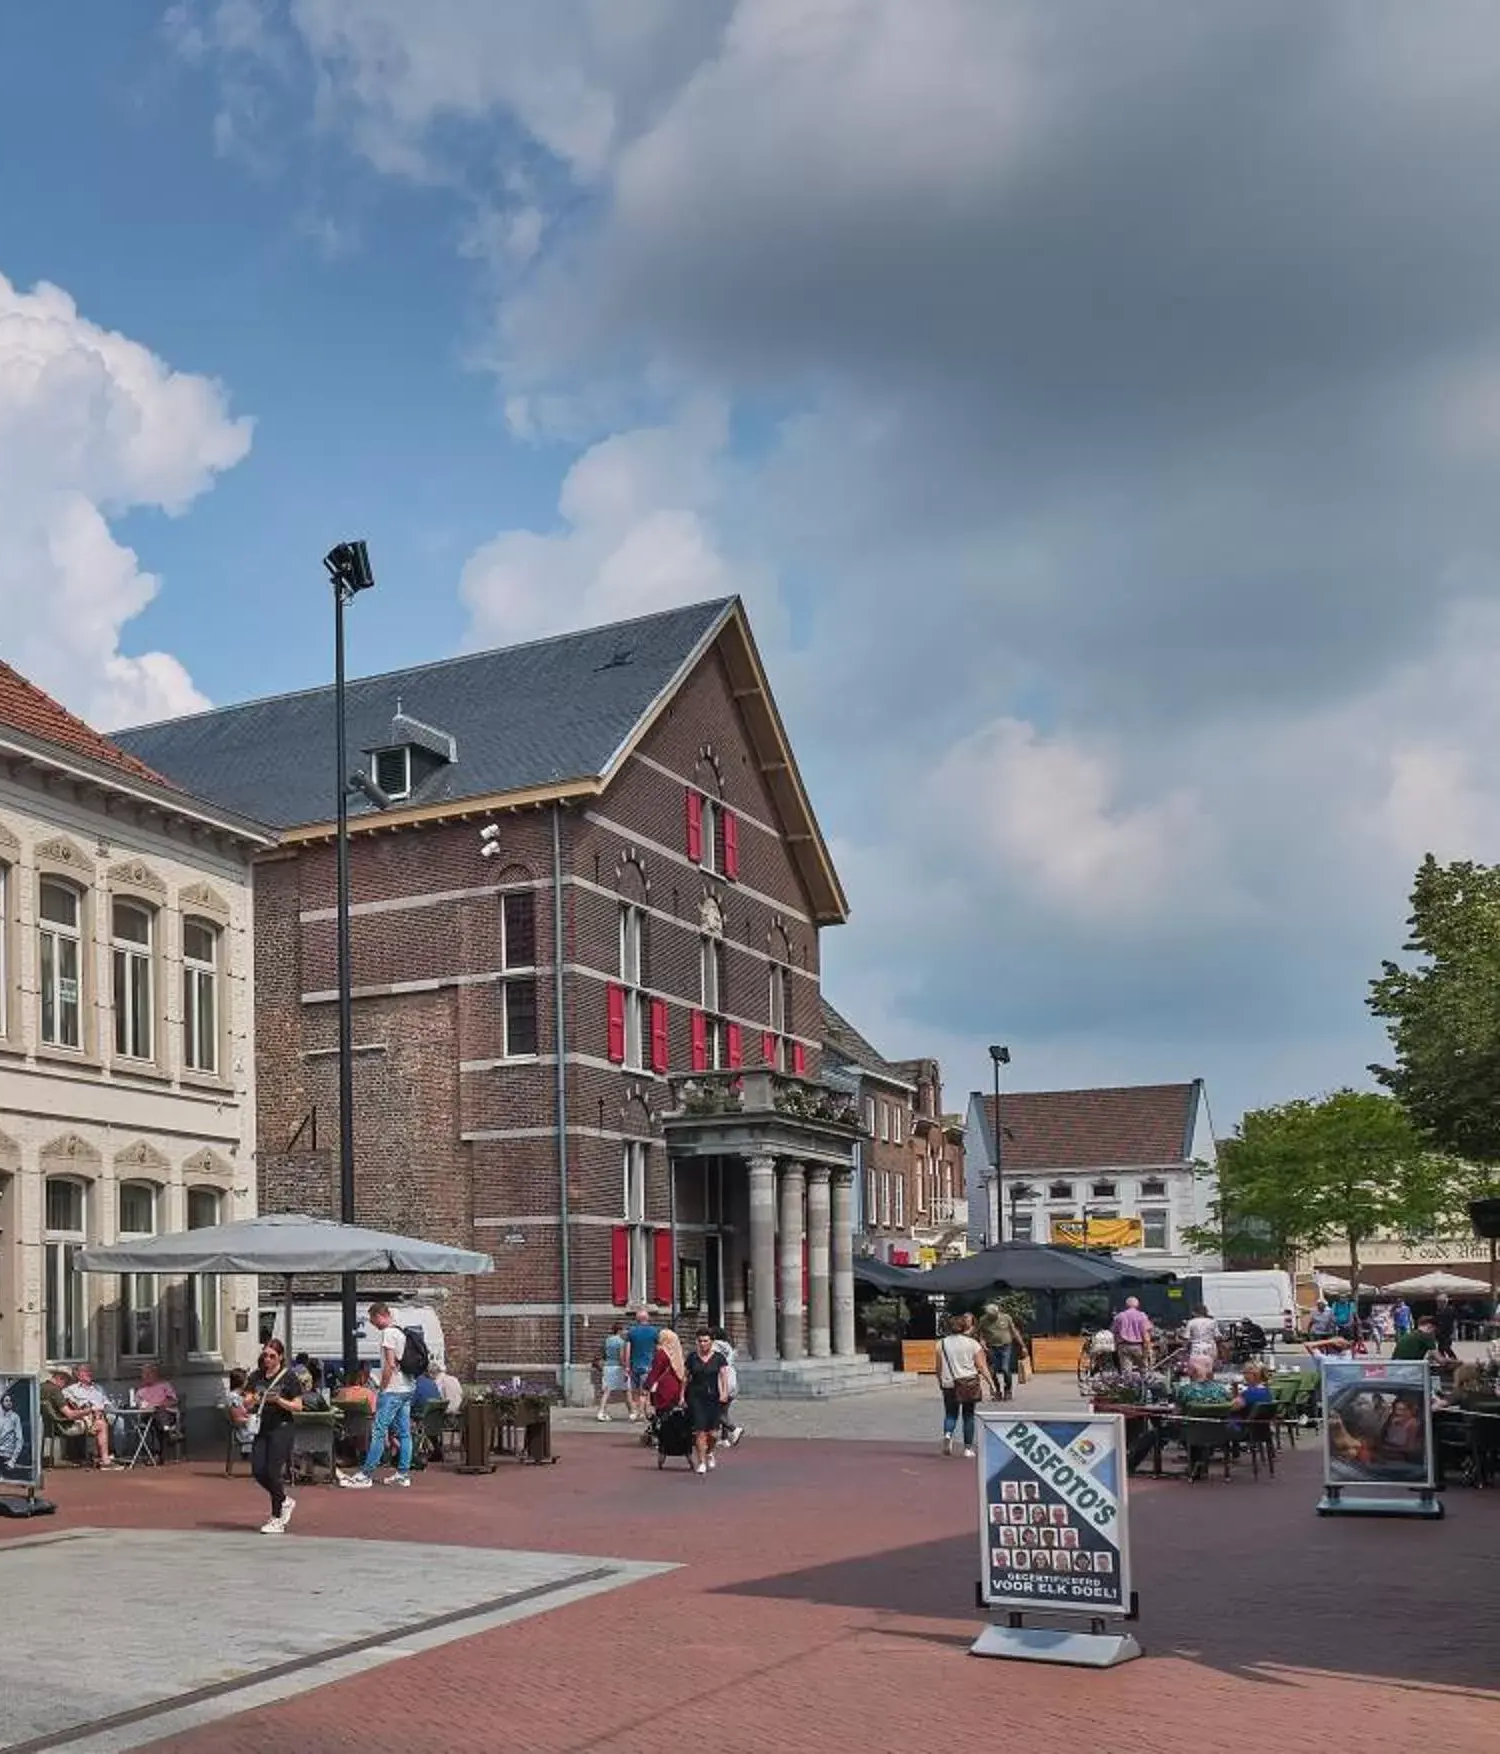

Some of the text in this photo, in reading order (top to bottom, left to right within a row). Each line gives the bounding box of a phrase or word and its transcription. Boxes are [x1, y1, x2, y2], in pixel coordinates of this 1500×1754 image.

[1005, 1422, 1118, 1526] PASFOTO'S
[993, 1579, 1117, 1599] VOOR ELK DOEL!
